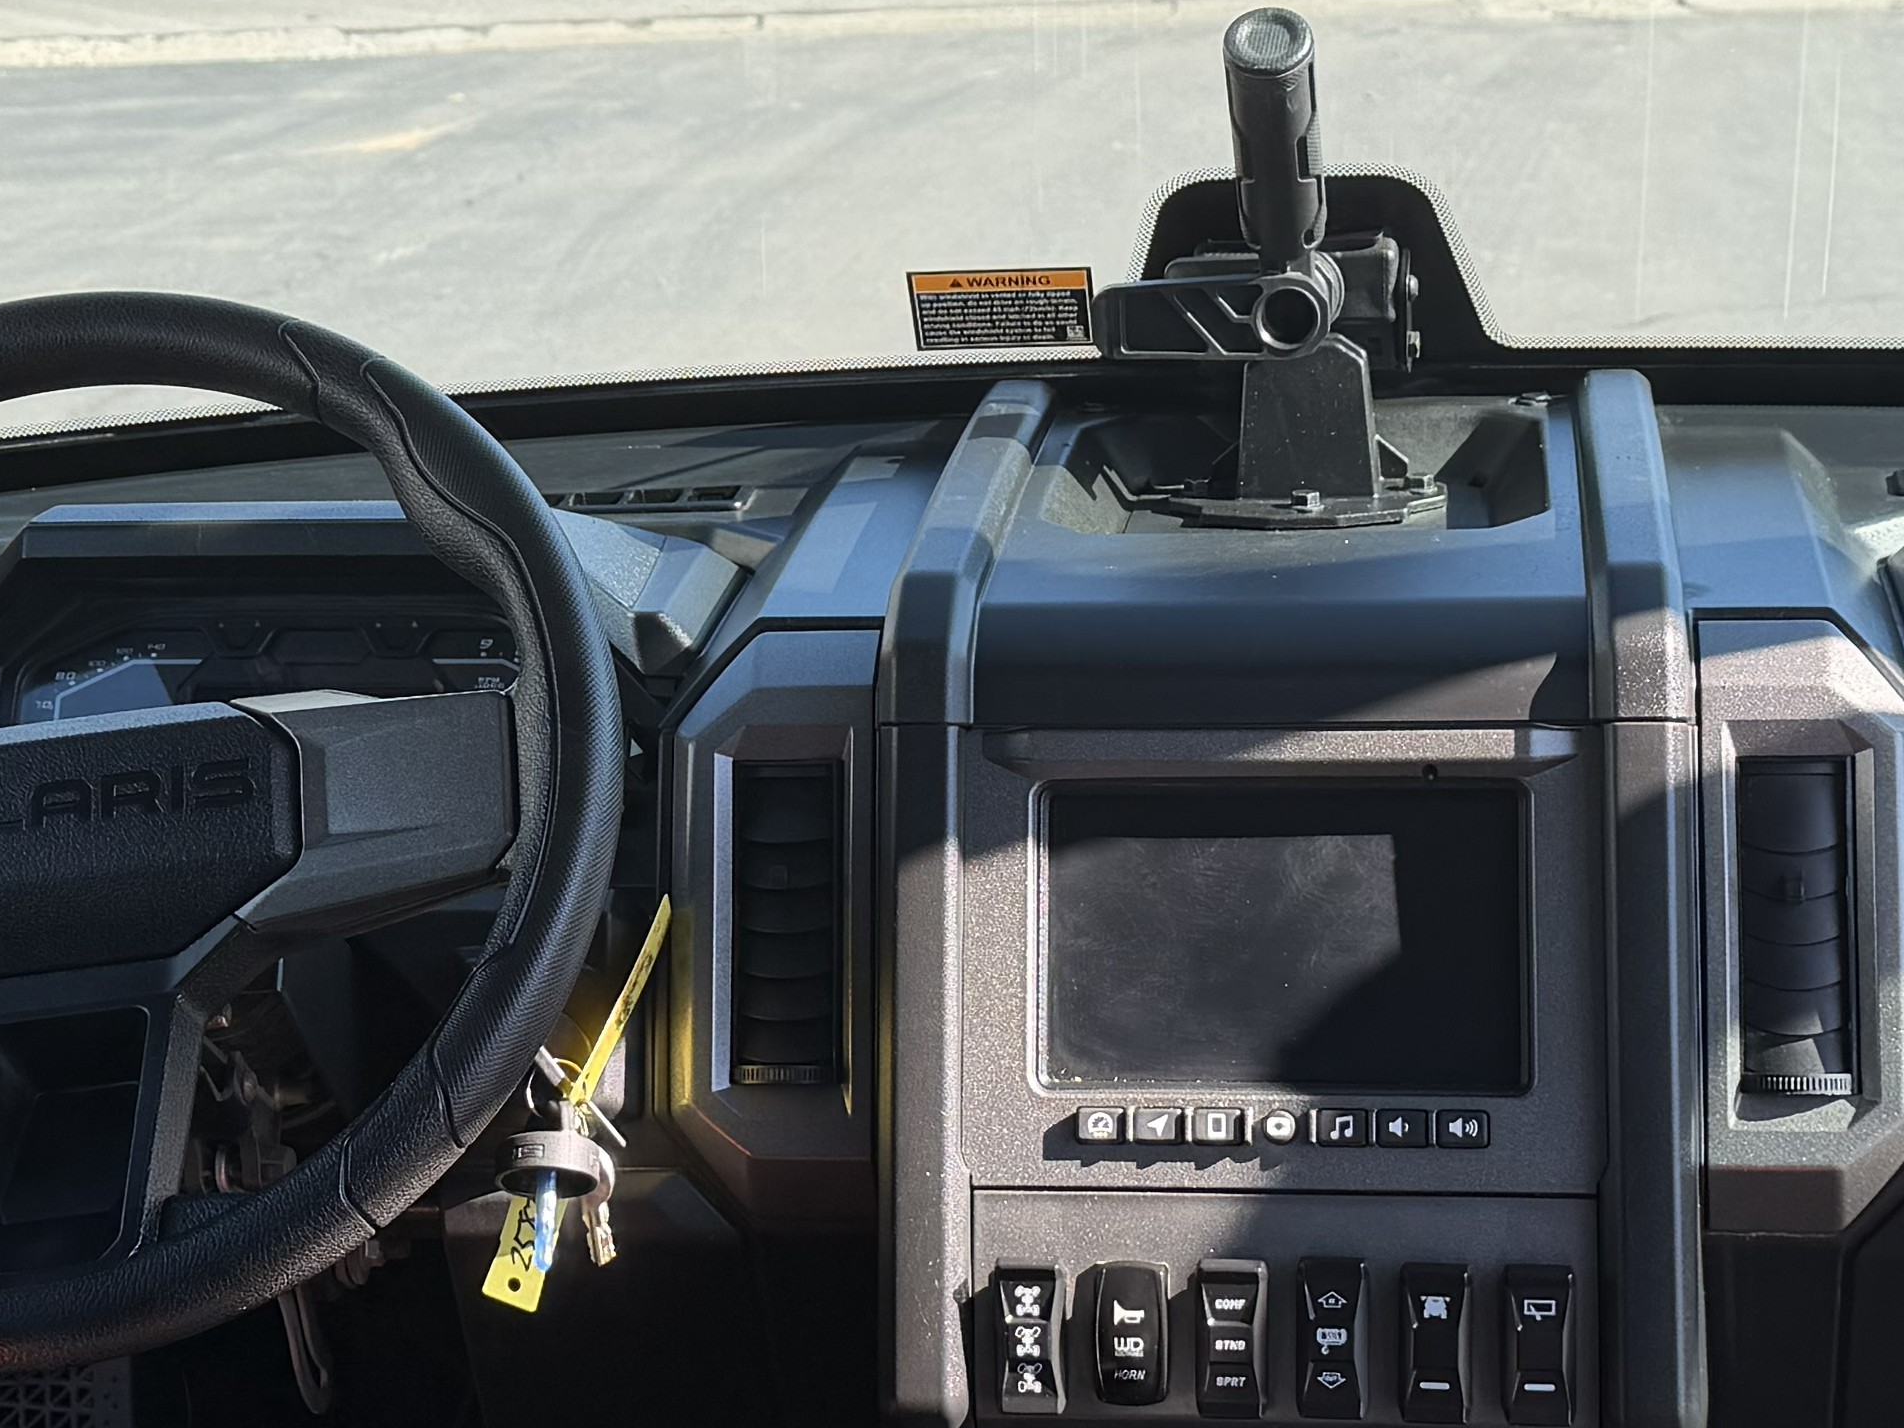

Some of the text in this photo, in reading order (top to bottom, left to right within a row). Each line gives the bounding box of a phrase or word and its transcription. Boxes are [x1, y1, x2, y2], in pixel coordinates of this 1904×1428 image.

[966, 274, 1051, 287] WARNING
[1114, 1369, 1146, 1380] HORN
[1216, 1376, 1246, 1388] SPRT
